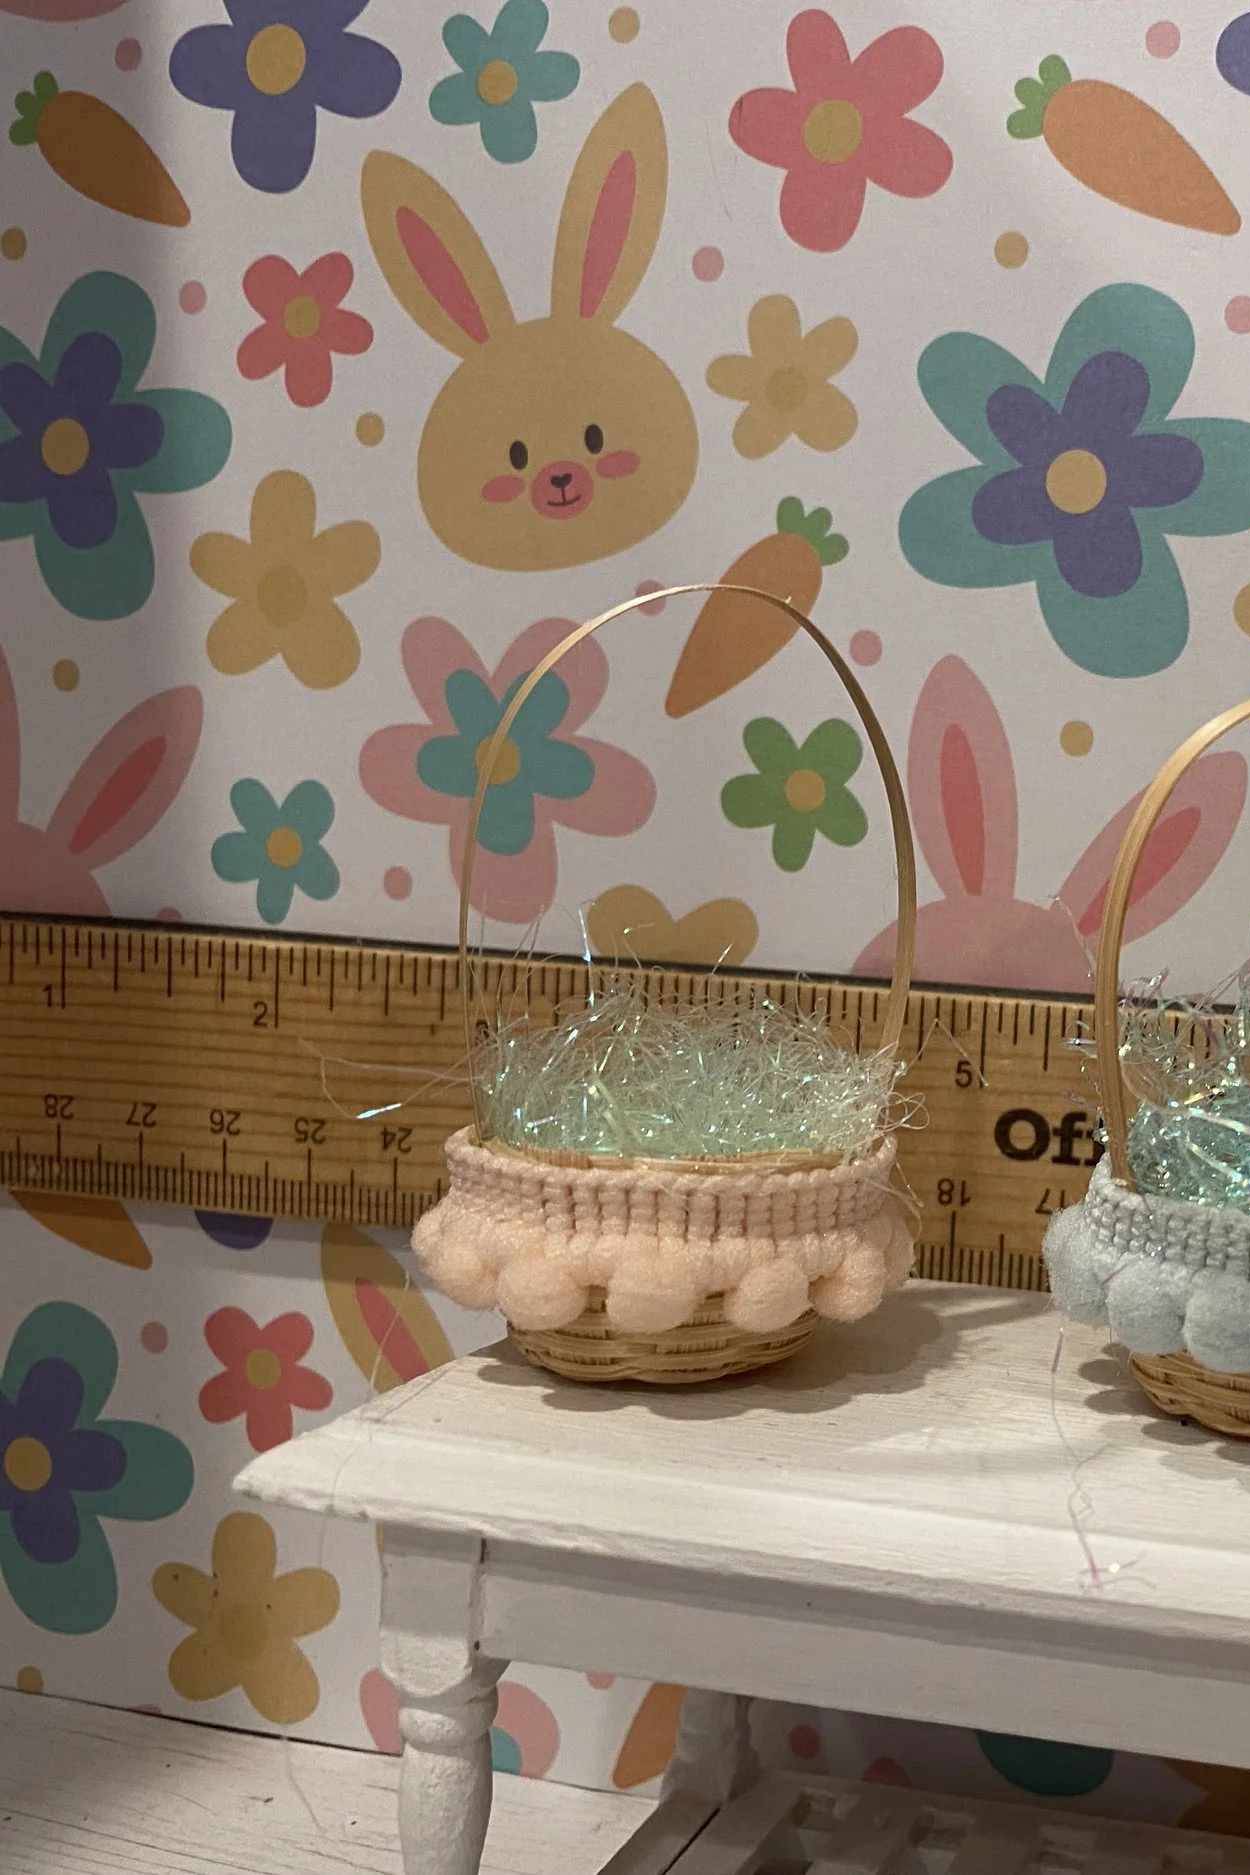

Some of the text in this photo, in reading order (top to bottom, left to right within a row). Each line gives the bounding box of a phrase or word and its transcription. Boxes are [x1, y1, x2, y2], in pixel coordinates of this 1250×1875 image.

[41, 983, 53, 1007] 1
[252, 1001, 269, 1027] 2
[955, 1060, 973, 1088] 5
[44, 1094, 75, 1120] 28
[126, 1101, 158, 1128] 27
[209, 1108, 242, 1136] 26
[294, 1117, 327, 1145] 25
[381, 1126, 413, 1153] 24
[937, 1177, 971, 1208] 18
